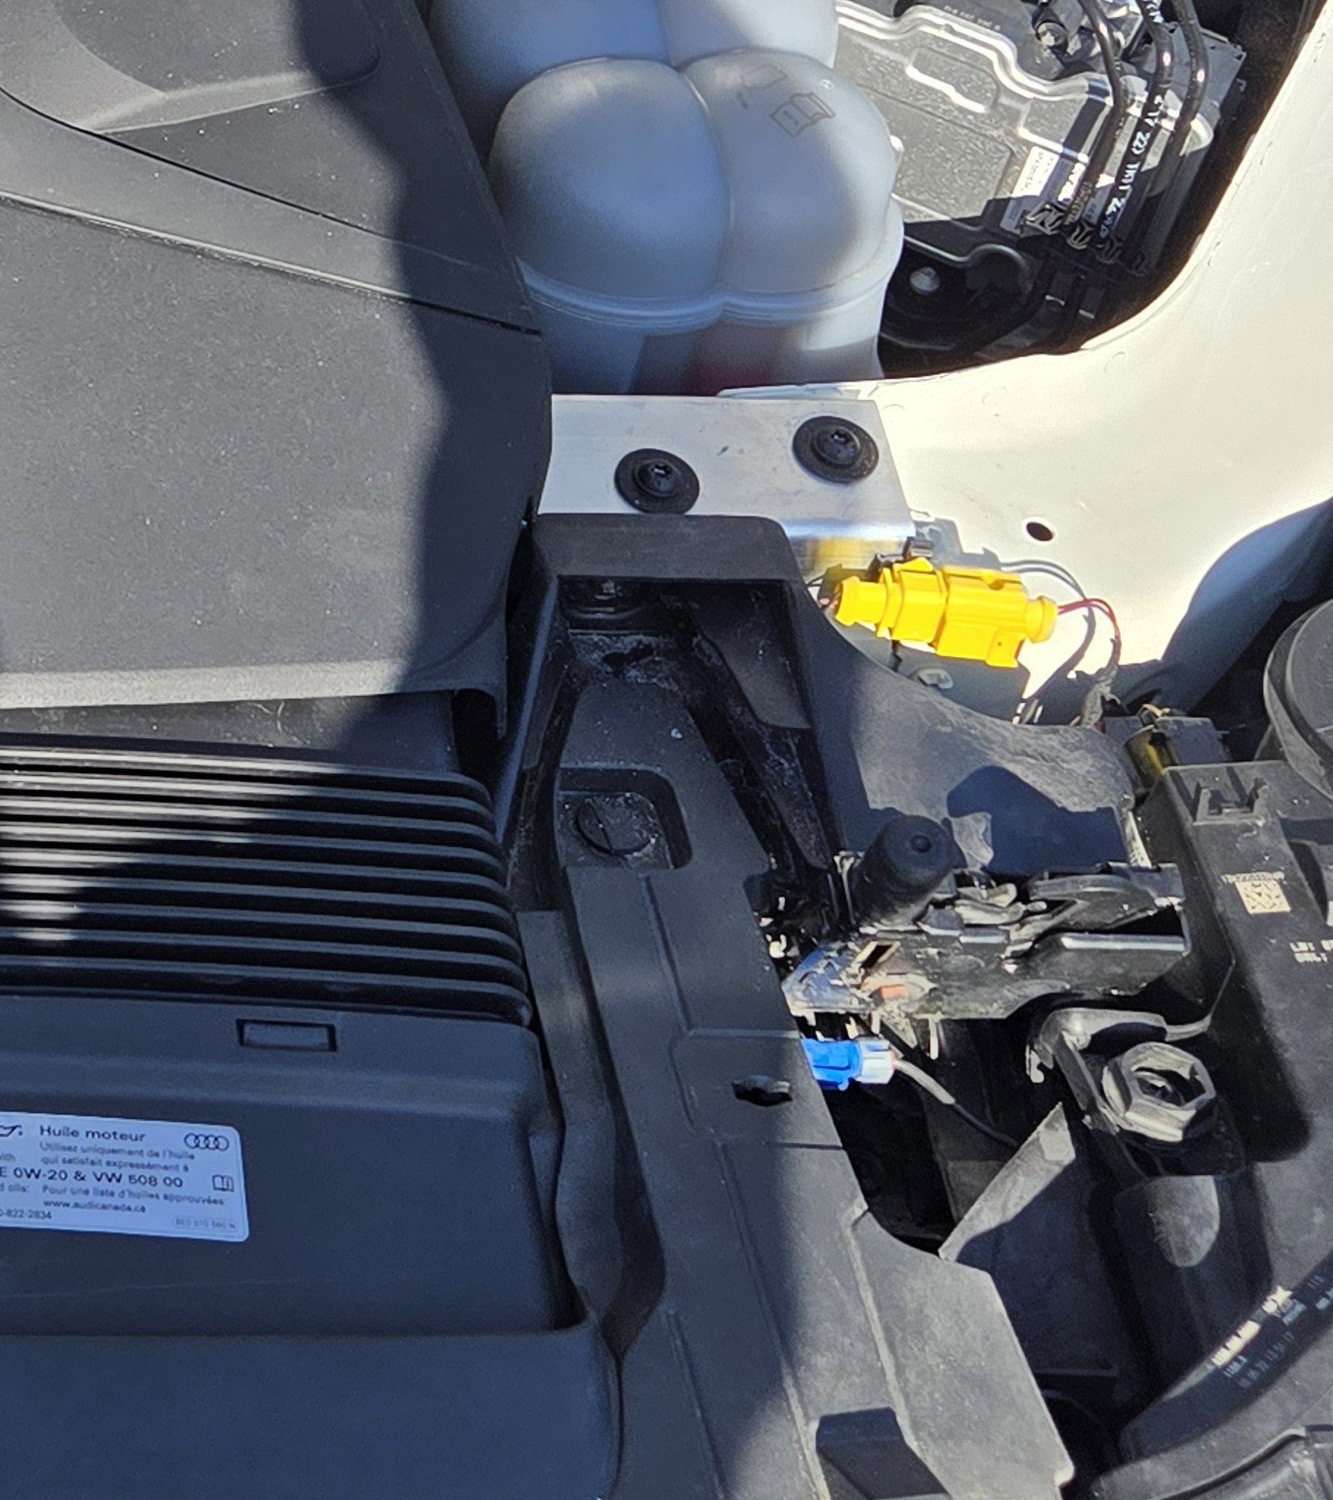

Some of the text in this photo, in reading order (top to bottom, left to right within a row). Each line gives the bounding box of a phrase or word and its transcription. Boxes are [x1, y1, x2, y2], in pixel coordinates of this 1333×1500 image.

[39, 1124, 147, 1143] Huile moteur
[13, 1167, 68, 1182] 0W-20
[73, 1170, 87, 1182] &
[92, 1171, 123, 1184] VW
[128, 1174, 159, 1188] 508
[162, 1176, 184, 1189] 00
